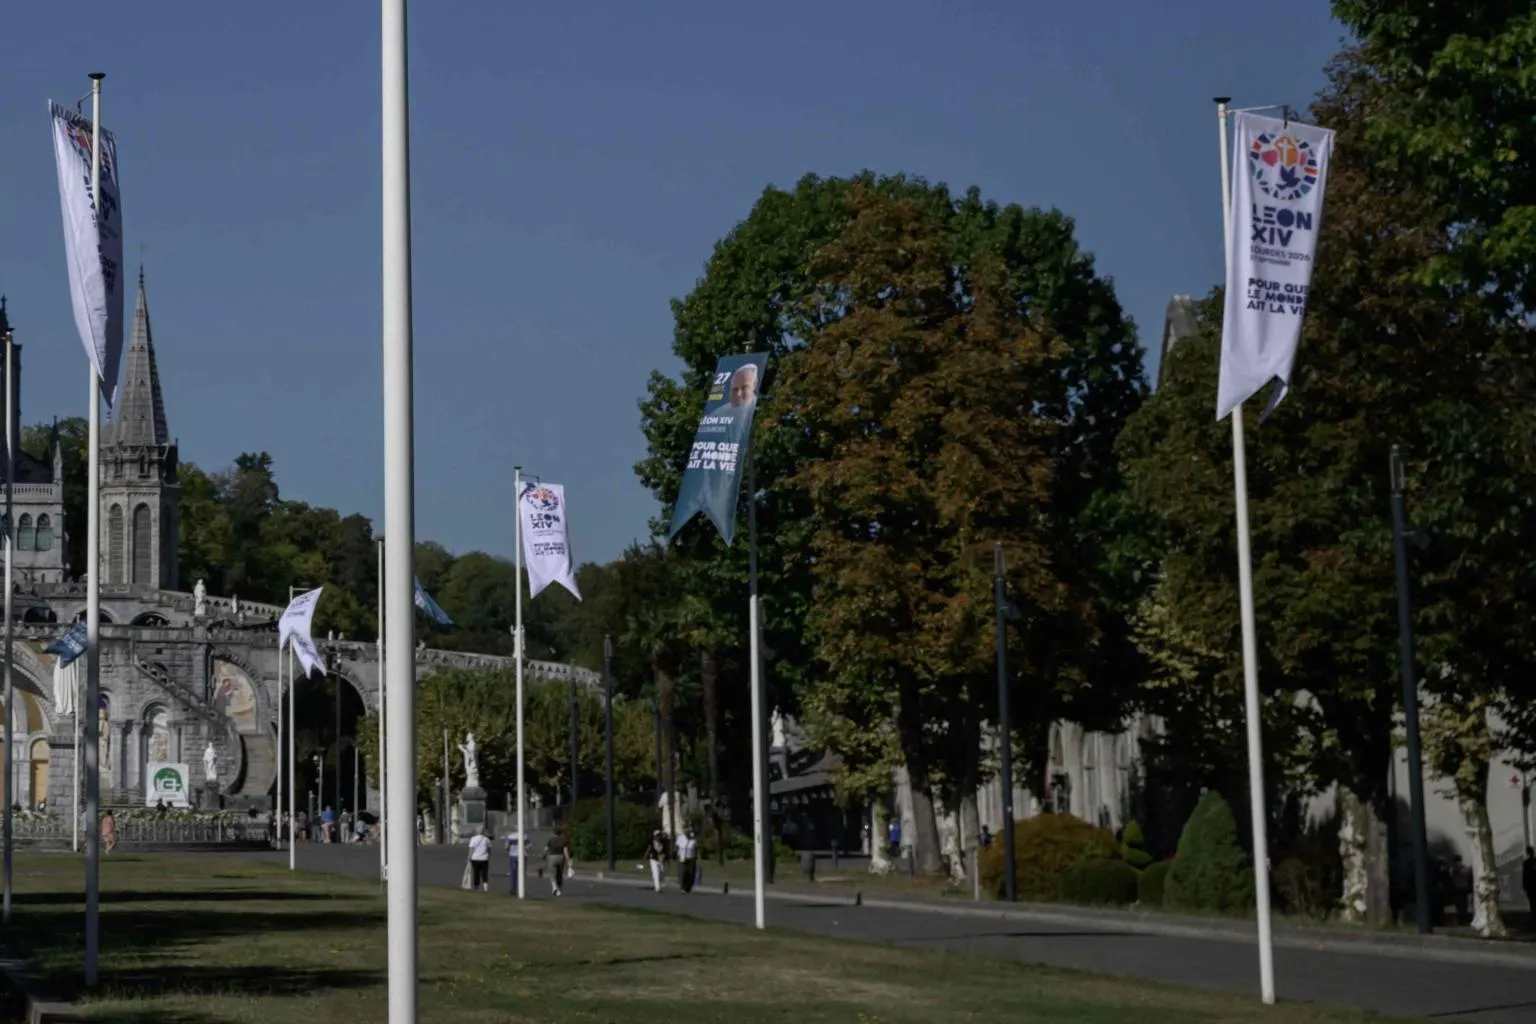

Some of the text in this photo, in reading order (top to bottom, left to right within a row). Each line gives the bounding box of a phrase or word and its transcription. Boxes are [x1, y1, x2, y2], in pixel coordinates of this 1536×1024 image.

[1252, 203, 1312, 231] LEON
[1251, 224, 1293, 247] XIV
[1248, 278, 1280, 291] POUR
[1248, 289, 1260, 299] LE
[1247, 300, 1266, 312] AIT
[1269, 303, 1285, 314] LA
[714, 372, 732, 385] 27
[719, 416, 734, 425] XIV
[693, 441, 740, 453] POUR QUE
[701, 451, 738, 462] MONDE
[687, 460, 737, 472] AIT LA VIE
[530, 513, 560, 523] LEON
[532, 520, 552, 529] XIV
